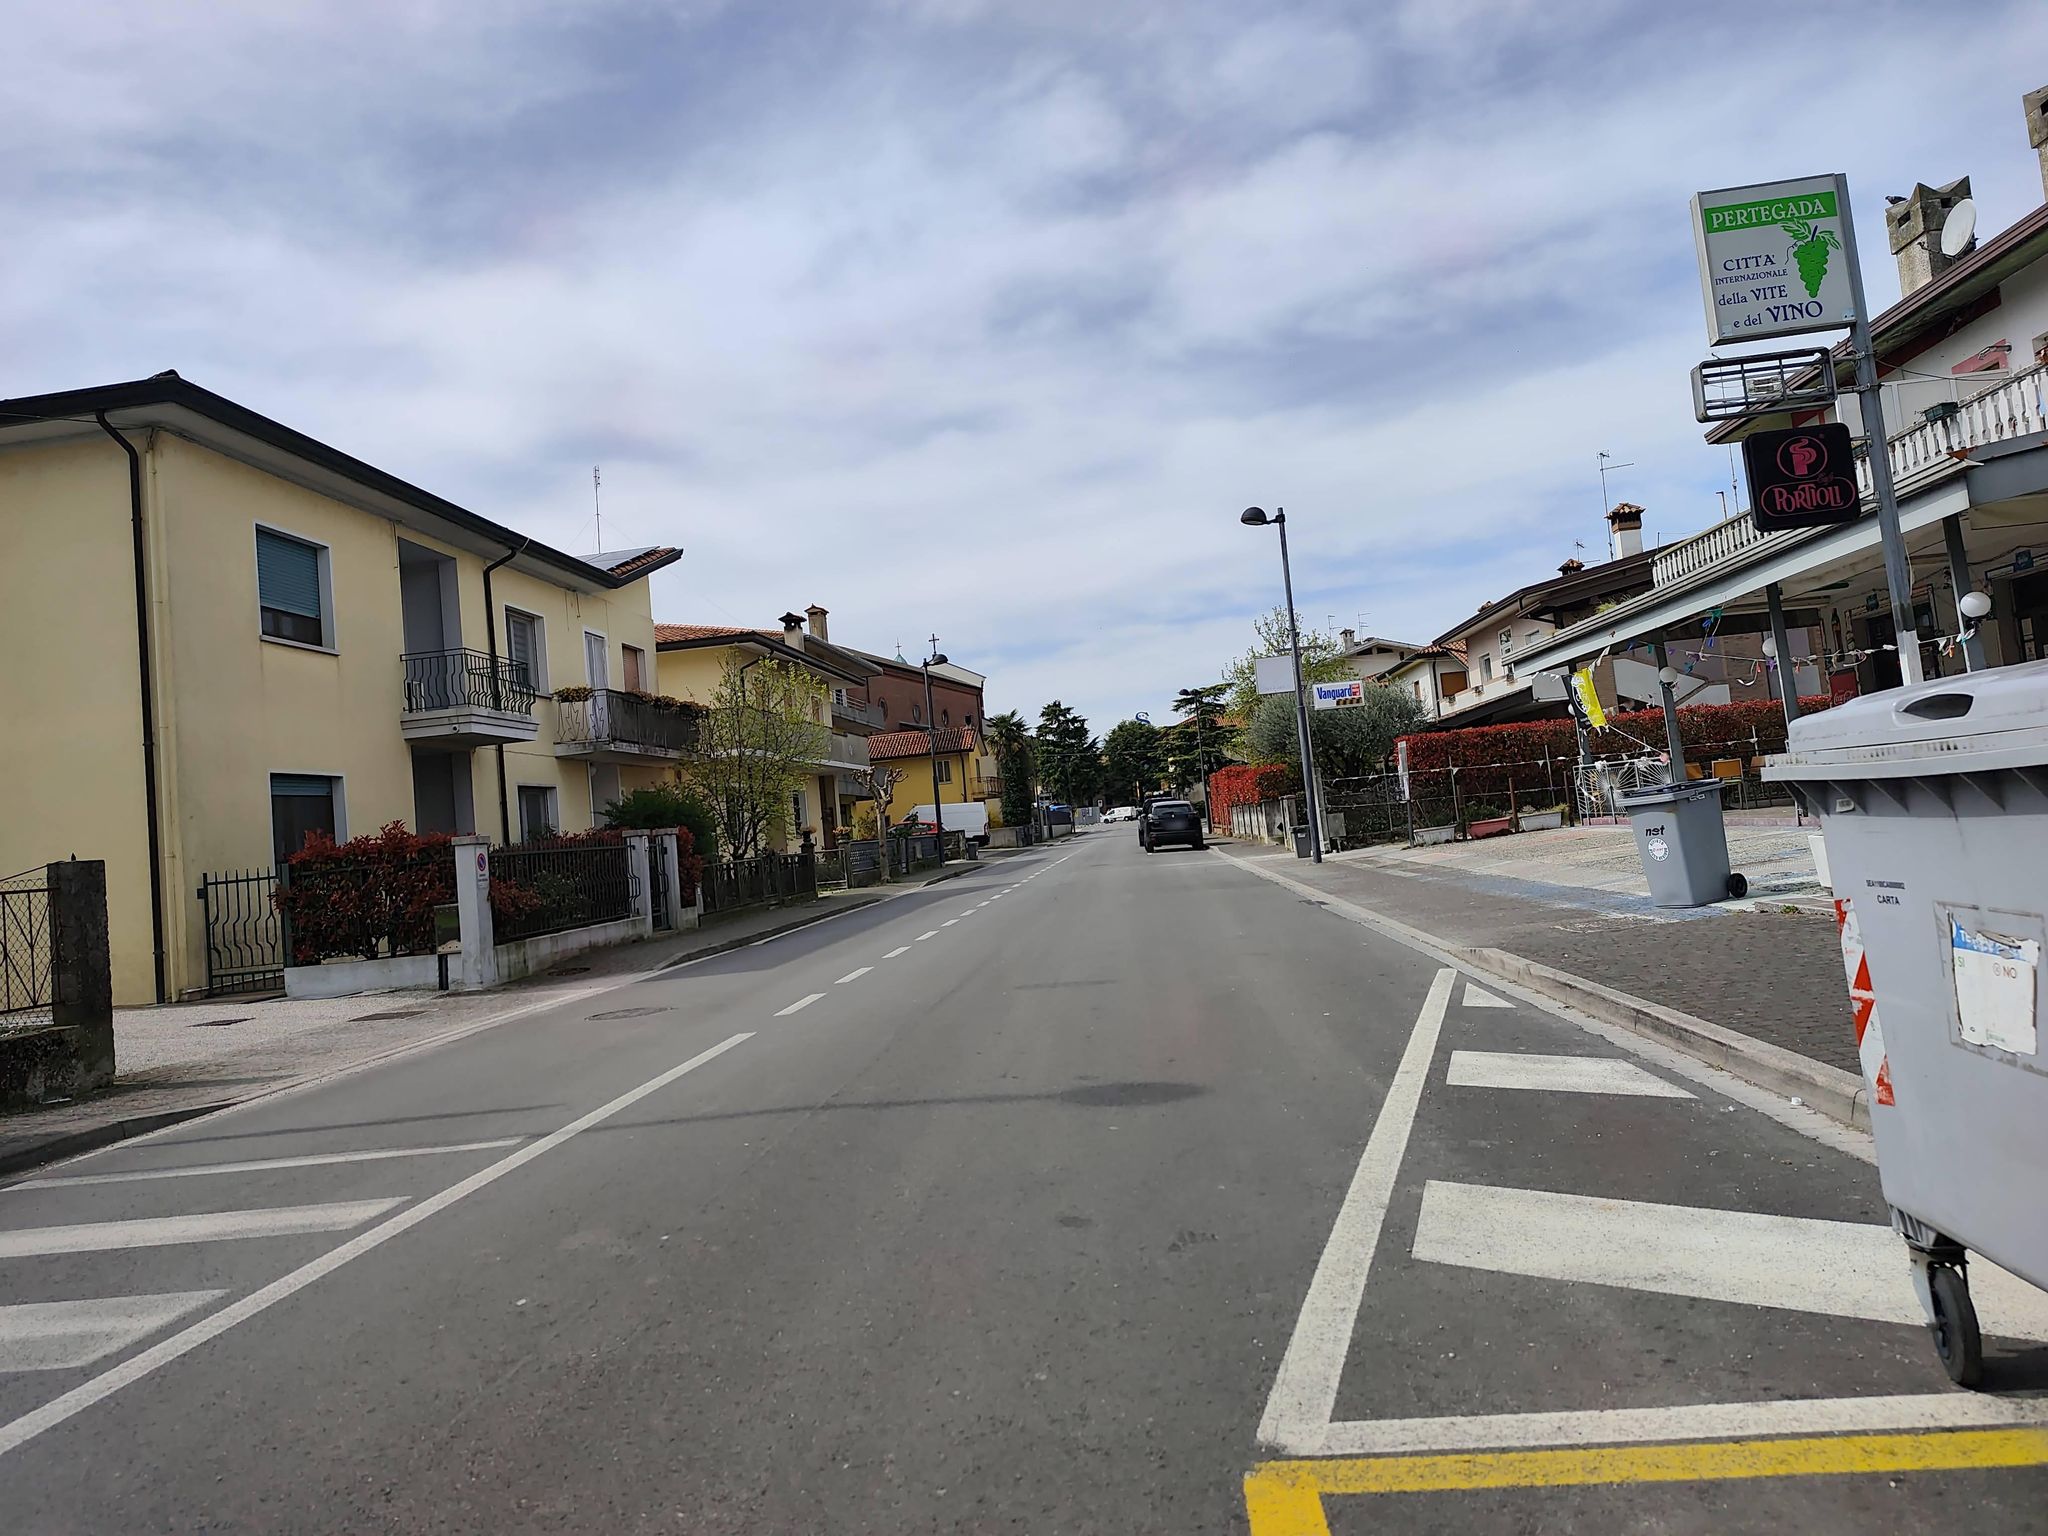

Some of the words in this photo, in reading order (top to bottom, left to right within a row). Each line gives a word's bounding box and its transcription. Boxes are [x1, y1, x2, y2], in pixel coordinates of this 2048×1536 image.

[1711, 199, 1827, 228] PERTEGADA
[1715, 268, 1788, 286] INTERNAZIONALE
[1718, 292, 1748, 306] della
[1750, 284, 1788, 301] VITE
[1733, 319, 1740, 328] e
[1743, 313, 1762, 327] del
[1765, 300, 1823, 322] VINO
[1317, 683, 1352, 700] Vanguard
[1645, 825, 1665, 837] net
[1876, 894, 1901, 906] CARTA
[2002, 965, 2017, 979] NO
